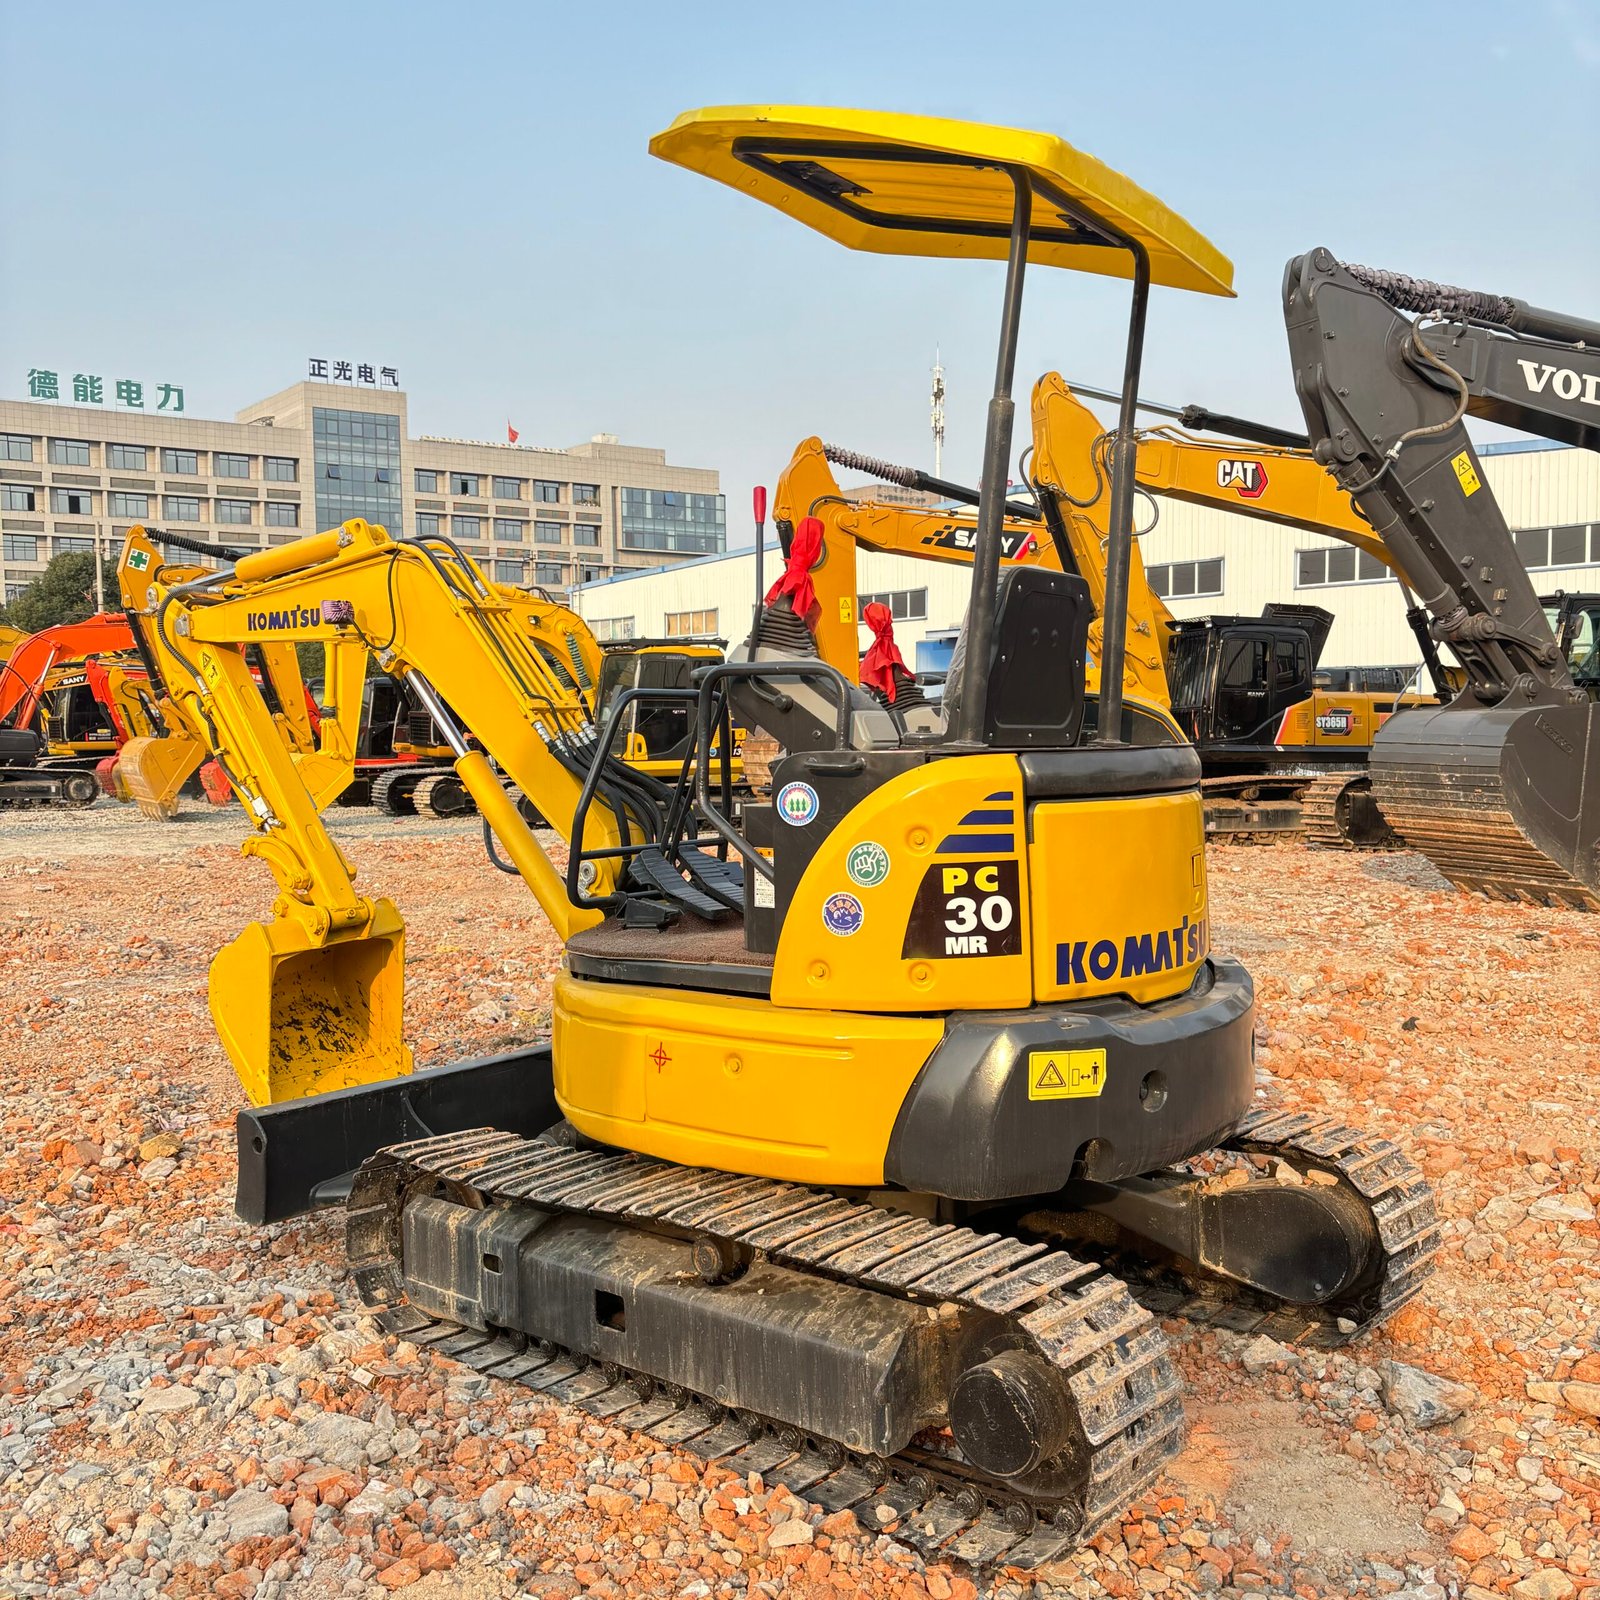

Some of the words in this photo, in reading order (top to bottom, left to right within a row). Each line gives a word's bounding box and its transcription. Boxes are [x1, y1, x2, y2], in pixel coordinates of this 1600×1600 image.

[309, 358, 399, 387] 正光电气
[28, 368, 184, 412] 德能电力
[1218, 460, 1256, 489] CAT
[248, 605, 320, 631] KOMATSU
[62, 675, 85, 685] SANY
[1316, 716, 1347, 728] SY365H
[943, 866, 998, 894] PC
[944, 895, 1013, 933] 30
[945, 935, 988, 955] MR
[1056, 915, 1206, 985] KOMATSU
